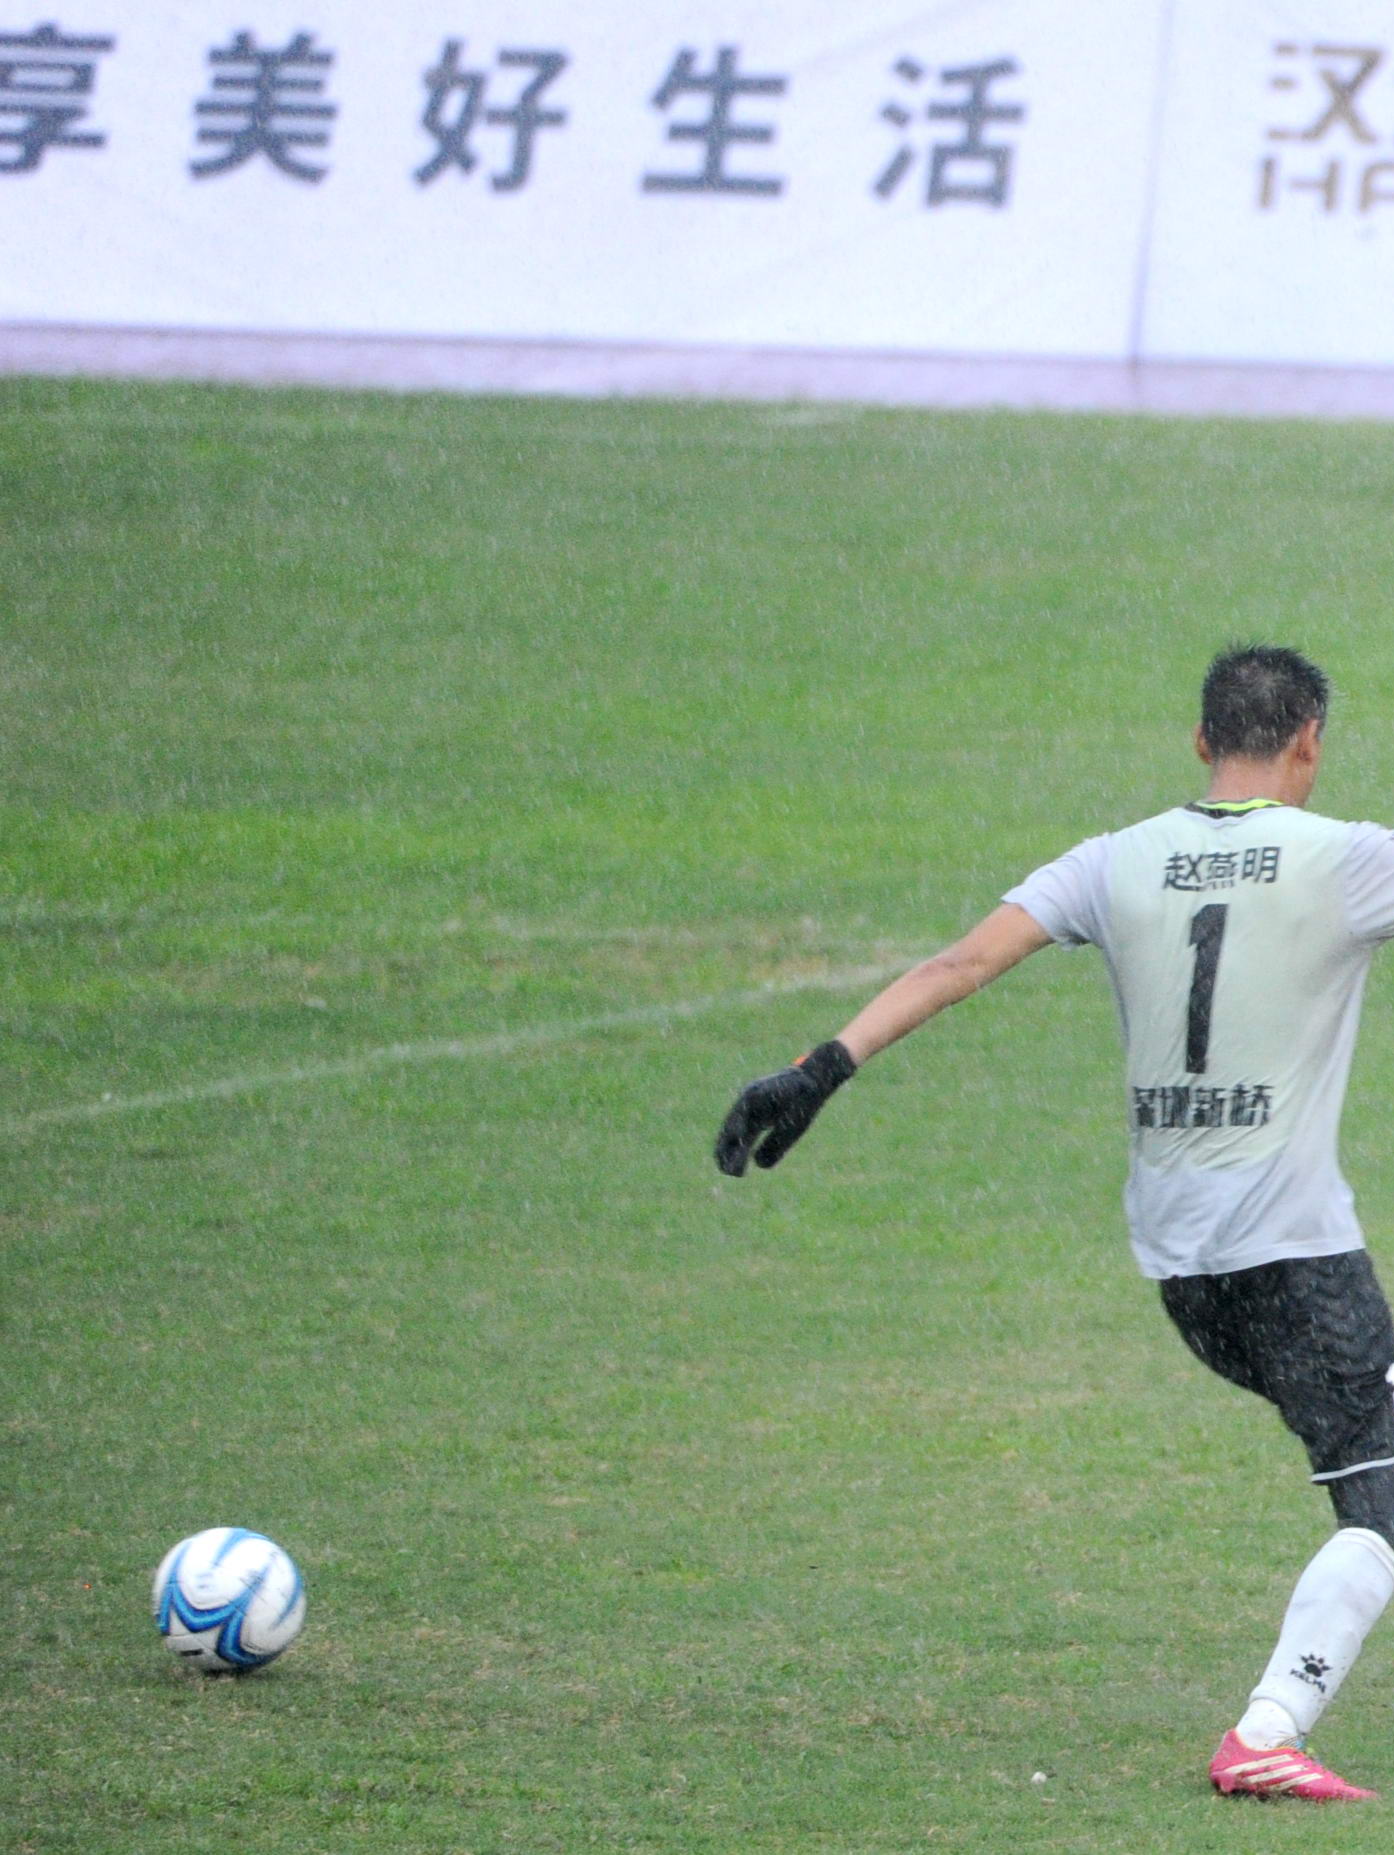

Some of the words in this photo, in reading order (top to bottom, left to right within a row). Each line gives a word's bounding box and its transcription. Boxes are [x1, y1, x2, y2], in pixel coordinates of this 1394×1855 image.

[0, 23, 1026, 208] 享美好生活
[1162, 846, 1281, 891] 赵燕明
[1186, 903, 1229, 1074] 1
